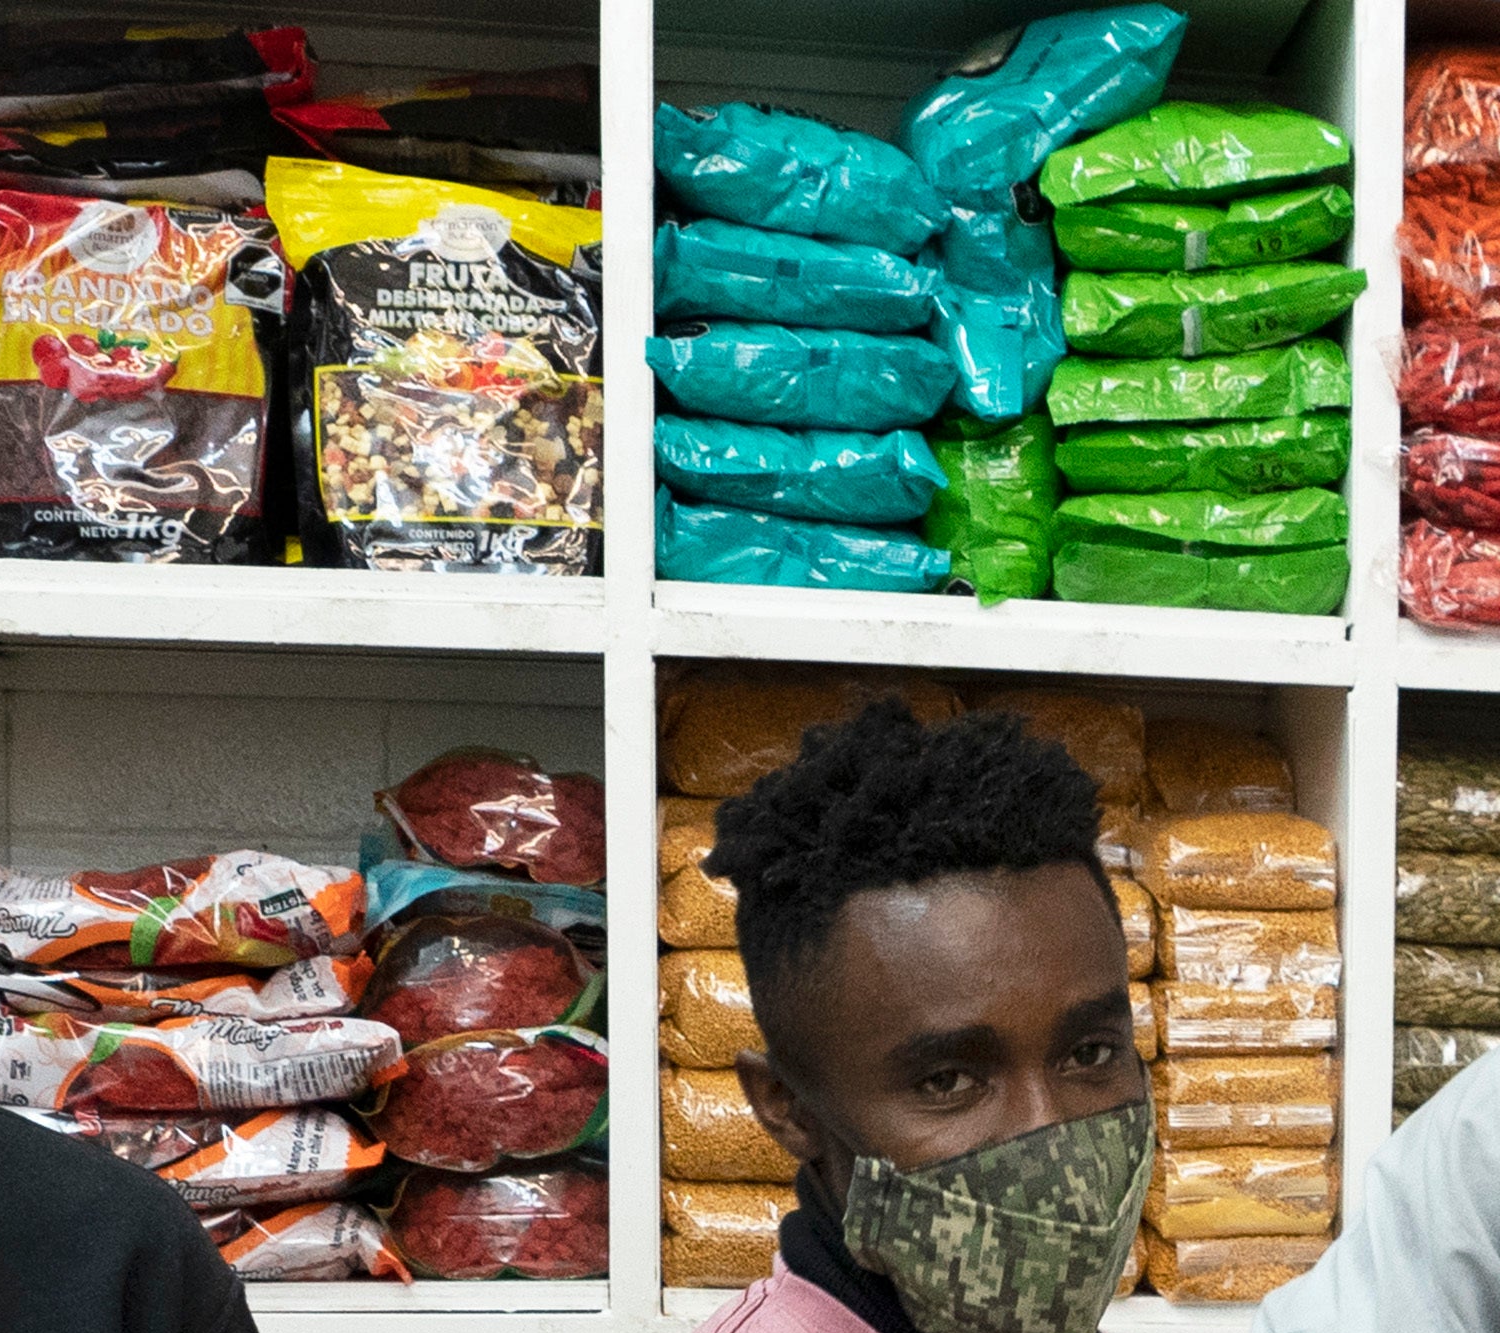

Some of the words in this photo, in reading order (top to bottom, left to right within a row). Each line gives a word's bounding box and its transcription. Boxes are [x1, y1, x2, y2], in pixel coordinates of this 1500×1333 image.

[408, 261, 510, 292] FRUTA
[1, 297, 214, 338] ENCHILADO
[79, 525, 119, 540] NETO
[122, 513, 184, 547] 1Kg
